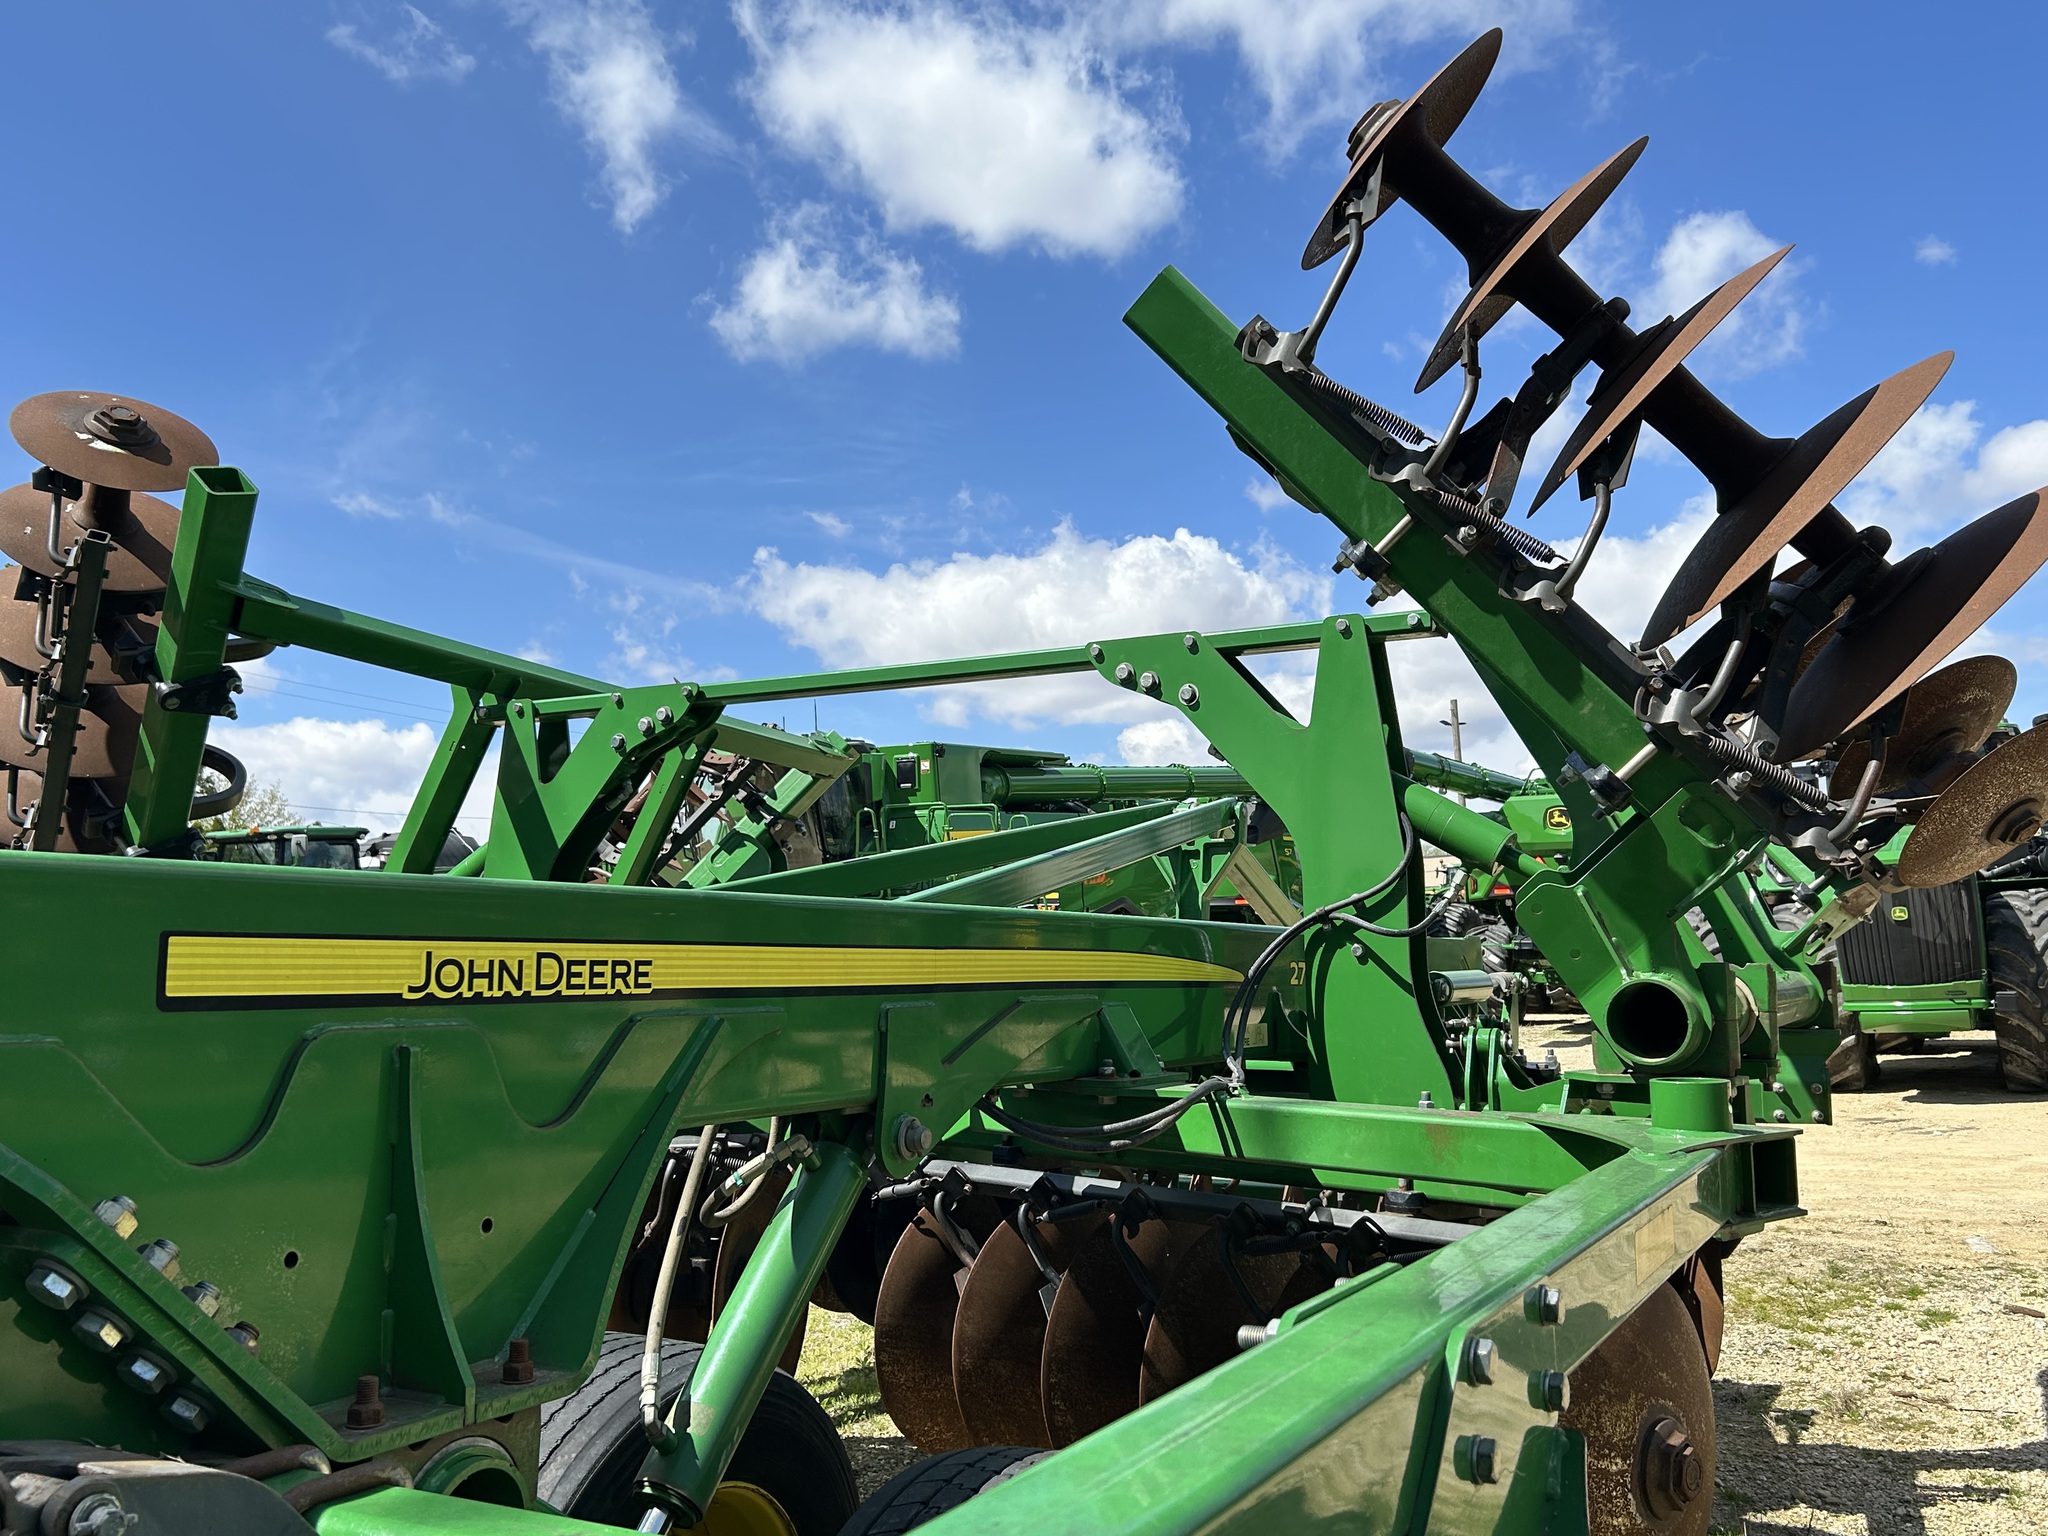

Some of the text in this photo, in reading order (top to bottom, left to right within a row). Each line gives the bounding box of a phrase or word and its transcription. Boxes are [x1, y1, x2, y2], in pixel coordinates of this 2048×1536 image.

[405, 950, 653, 995] JOHN DEERE
[1290, 961, 1306, 985] 27
